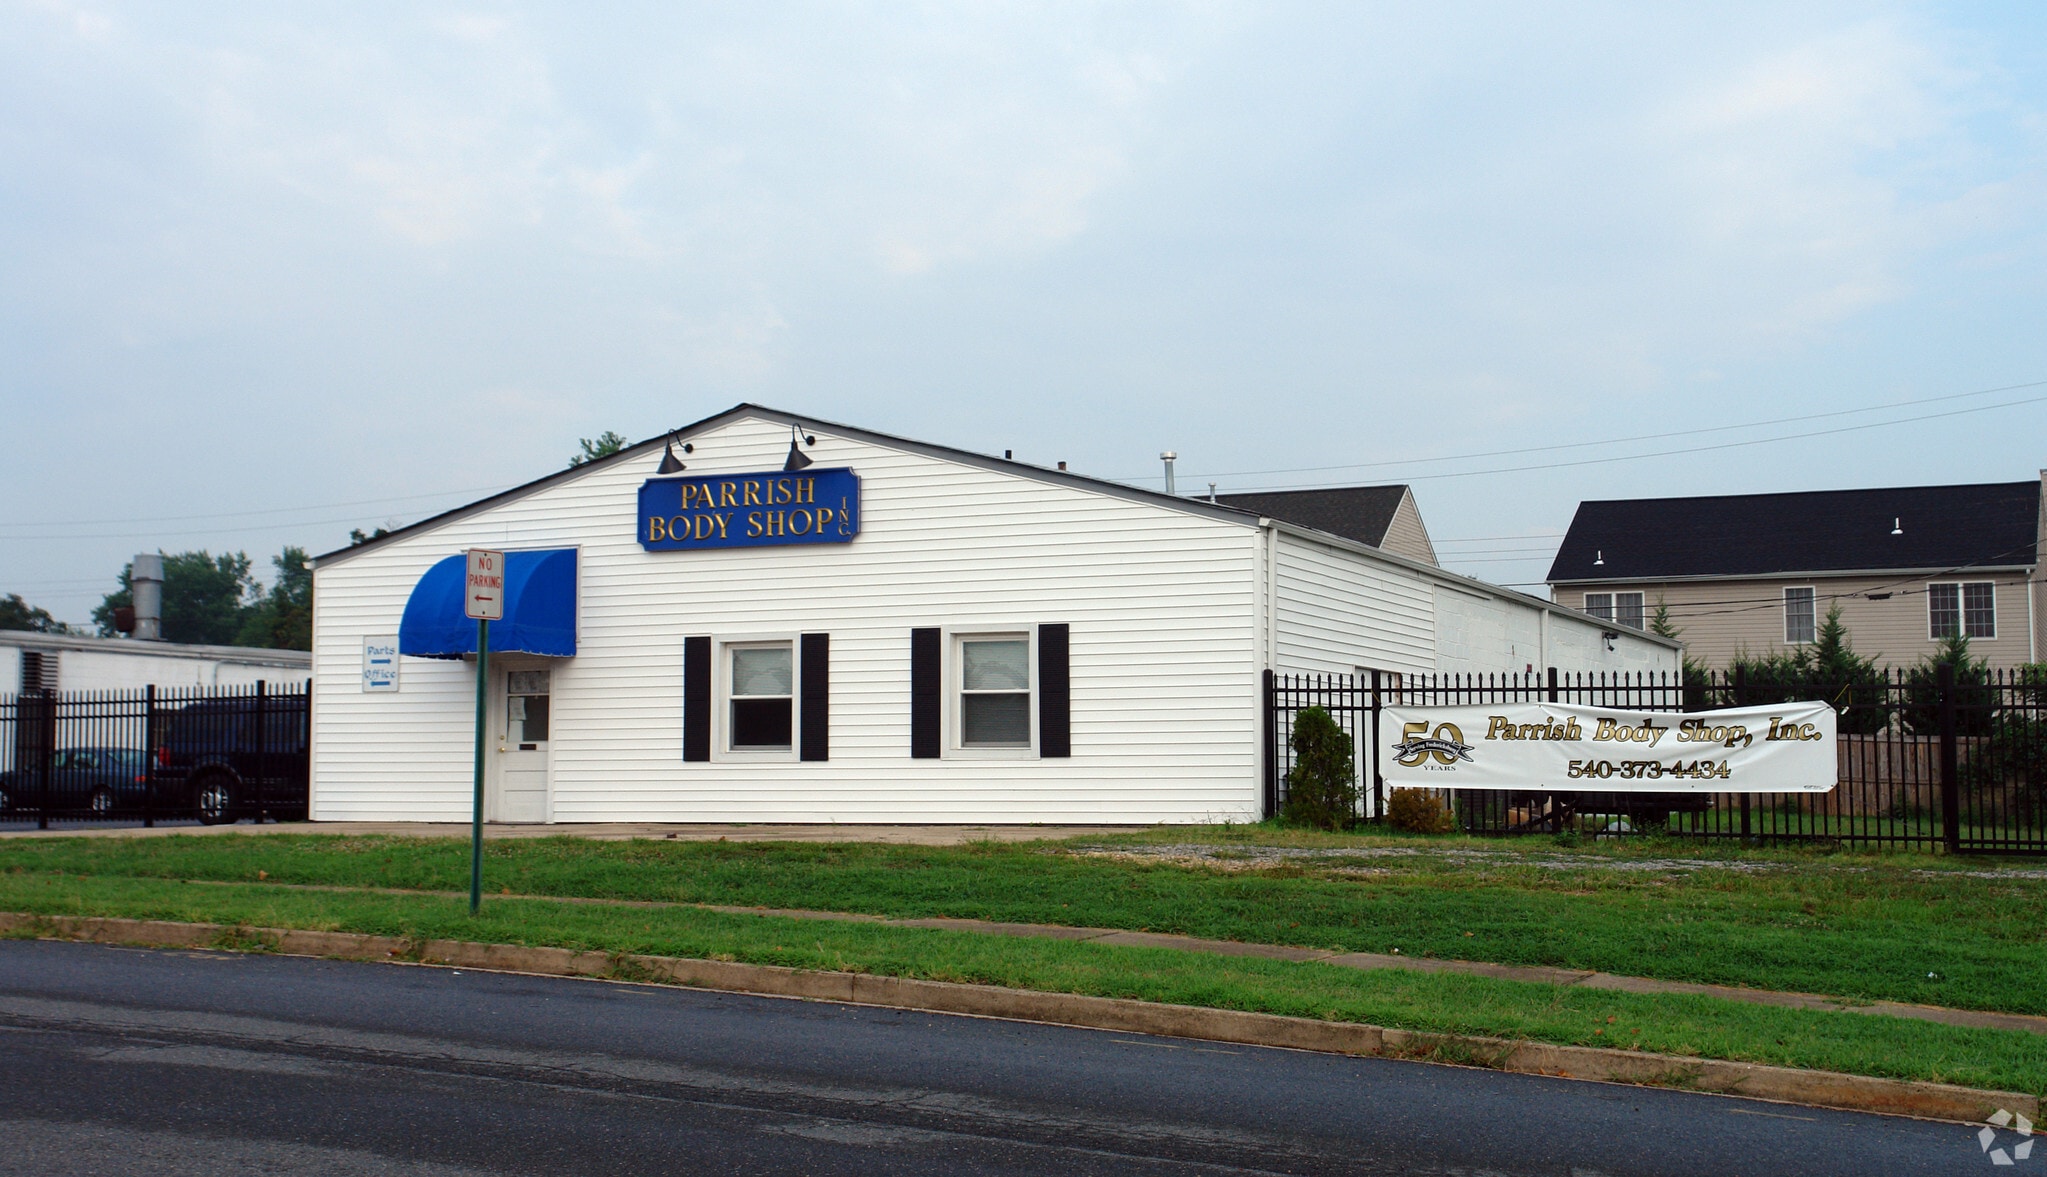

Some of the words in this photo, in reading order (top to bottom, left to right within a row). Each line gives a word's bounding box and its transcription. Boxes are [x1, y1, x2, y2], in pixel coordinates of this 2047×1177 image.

[681, 477, 815, 510] PARRISH
[649, 513, 733, 542] BODY
[747, 508, 833, 537] SHOP
[479, 557, 492, 570] NO
[469, 574, 502, 588] PARKING
[367, 646, 395, 655] Parts
[364, 669, 396, 680] Office
[1485, 716, 1582, 741] Parrish
[1593, 717, 1668, 748] Body
[1677, 718, 1753, 748] Shop,
[1765, 716, 1822, 741] Inc.
[1398, 720, 1464, 767] 50
[1568, 760, 1731, 778] 540-373-4434
